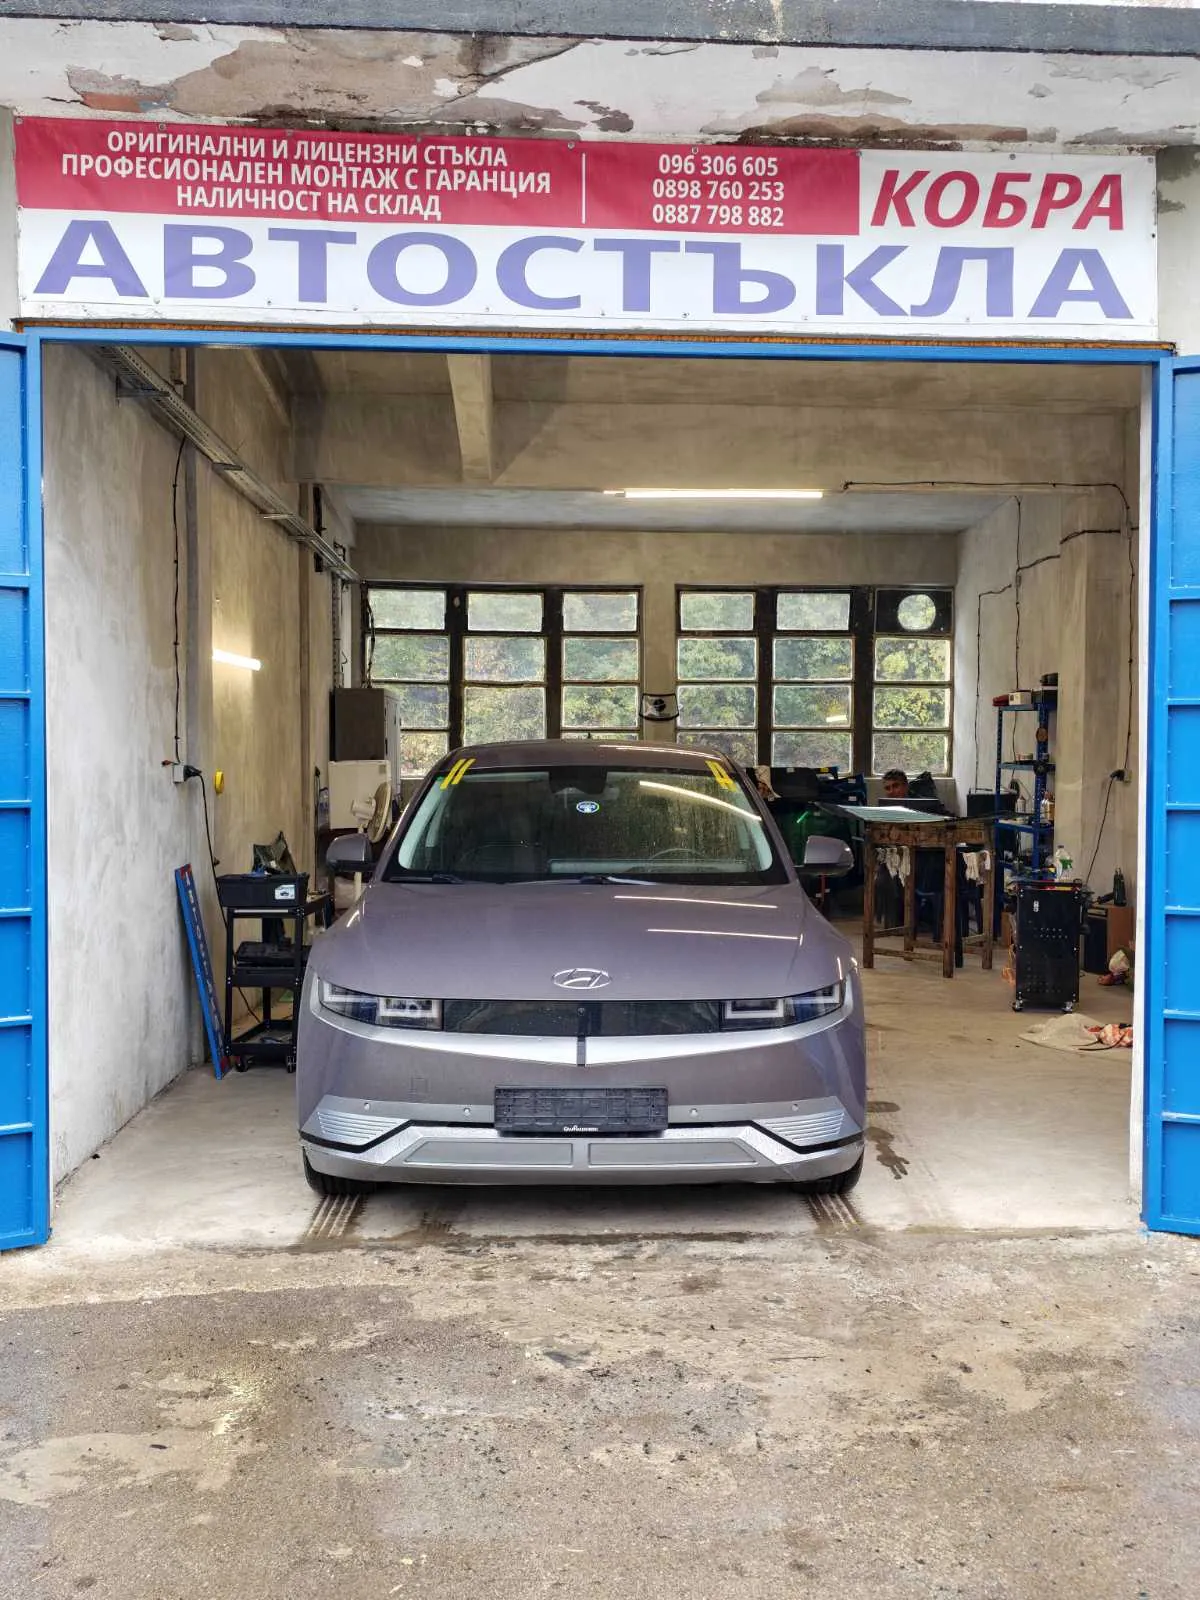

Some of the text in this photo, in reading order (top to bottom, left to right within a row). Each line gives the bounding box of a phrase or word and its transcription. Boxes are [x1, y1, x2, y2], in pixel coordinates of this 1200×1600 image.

[107, 131, 508, 167] ОРИГИНАЛНИ И ЛИЦЕНЗНИ СТЪКЛА
[658, 154, 778, 177] 096 306 605
[62, 153, 551, 199] ПРОФЕСИОНАЛЕН МОНТАЖ С ГАРАНЦИЯ
[652, 179, 785, 202] 0898 760 253
[176, 185, 442, 222] НАЛИЧНОСТ НА СКЛАД
[652, 203, 785, 227] 0887 798 882
[871, 169, 1124, 230] КОБРА
[33, 219, 1134, 319] АВТОСТЪКЛА
